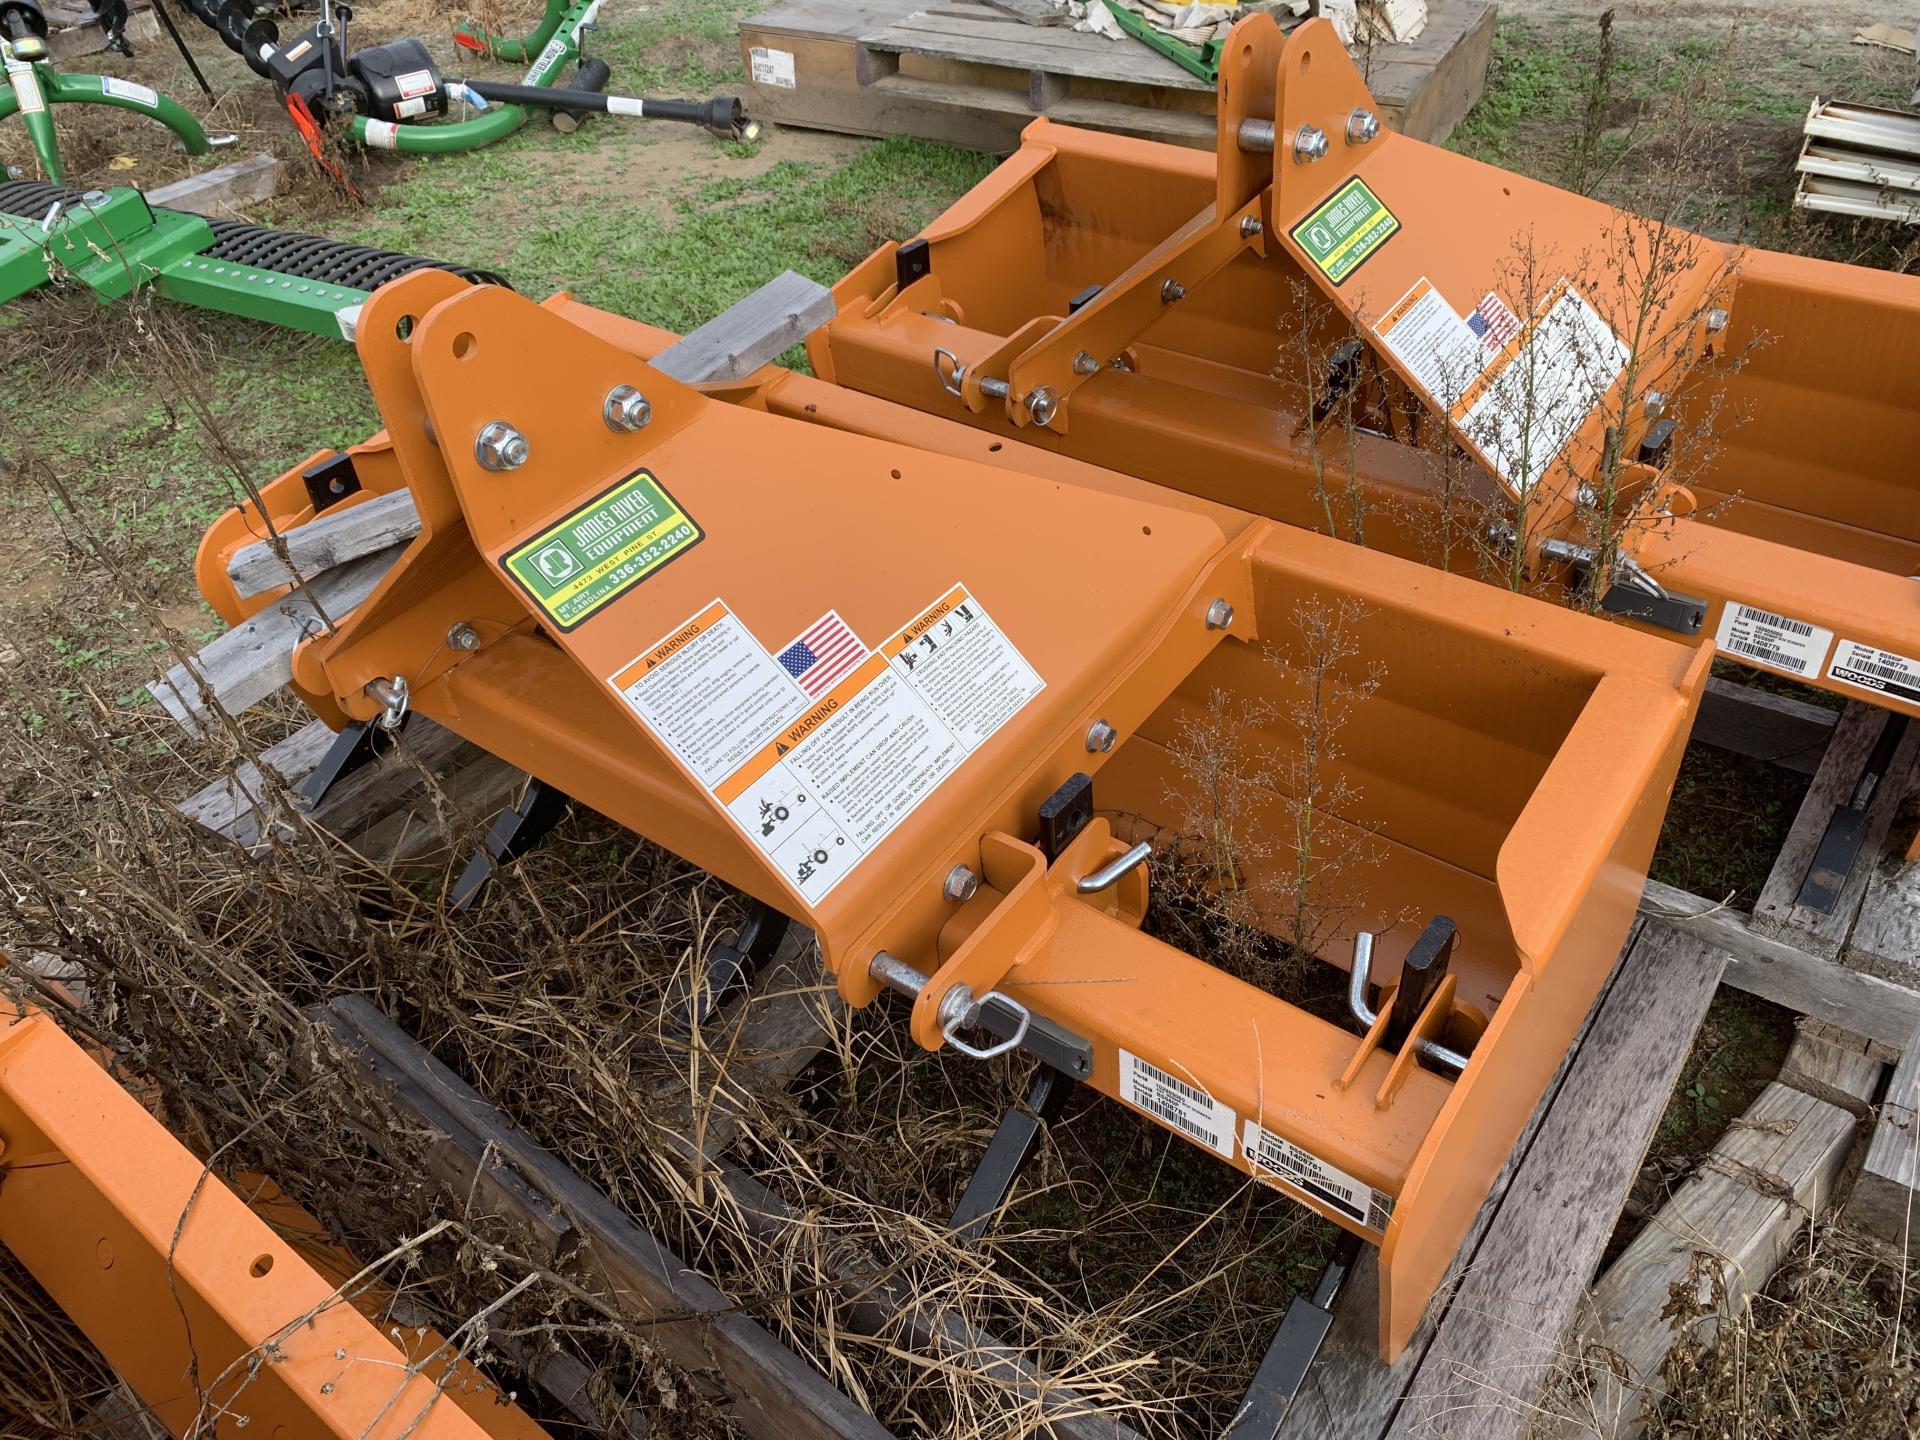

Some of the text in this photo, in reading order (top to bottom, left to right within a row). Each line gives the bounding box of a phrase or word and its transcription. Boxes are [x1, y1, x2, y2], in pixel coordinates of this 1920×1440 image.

[535, 40, 566, 72] FRONTIER
[1324, 189, 1364, 228] JAMES RIVER
[1335, 203, 1371, 237] EQUIPMENT
[1352, 217, 1392, 255] 336-352-2240
[1336, 255, 1355, 273] CAROLINA
[1395, 293, 1418, 316] WARNING
[572, 489, 649, 547] JAMES RIVER
[586, 508, 658, 560] EQUIPMENT
[573, 574, 593, 589] 4473
[595, 555, 619, 574] WEST
[622, 541, 643, 555] PINE
[609, 525, 690, 583] 336-352-2240
[557, 589, 589, 614] MT. AIRY
[571, 585, 611, 613] CAROLINA
[910, 602, 950, 634] WARNING
[1731, 627, 1750, 635] Model#
[1753, 633, 1774, 642] BSS60P
[654, 624, 700, 659] WARNING
[915, 622, 980, 677] CRUSHING AND PINCHING HAZARD
[1730, 632, 1748, 640] Serial#
[1752, 638, 1780, 651] 1408779
[1854, 645, 1902, 662] Model# BSS60P
[634, 682, 644, 690] TO
[642, 670, 660, 684] AVOID
[658, 653, 681, 672] SERIOUS
[680, 640, 699, 656] INJURY
[697, 634, 707, 642] OR
[1851, 650, 1907, 670] Serial# 1408779
[1835, 667, 1885, 689] WOODS
[703, 756, 723, 773] FAILURE
[727, 737, 747, 753] FOLLOW
[746, 726, 760, 738] THESE
[759, 702, 789, 728] INSTRUCTIONS
[787, 695, 797, 704] CAN
[787, 698, 838, 741] WARNING
[788, 744, 811, 765] FALLING
[809, 735, 821, 747] OFF
[819, 726, 831, 738] CAN
[830, 711, 849, 729] RESULT
[853, 694, 869, 709] BEING
[867, 685, 879, 696] RUN
[727, 747, 744, 762] RESULT
[748, 731, 764, 745] INJURY
[820, 781, 840, 800] RAISED
[838, 757, 866, 784] IMPLEMENT
[865, 748, 876, 760] CAN
[875, 736, 889, 750] DROP
[888, 727, 899, 738] AND
[855, 819, 874, 838] FALLING
[874, 810, 884, 820] OFF
[884, 802, 892, 811] OR
[891, 788, 906, 803] GOING
[906, 763, 933, 789] UNDERNEATH
[932, 741, 956, 764] IMPLEMENT
[860, 832, 872, 844] CAN
[871, 816, 888, 833] RESULT
[894, 792, 913, 811] SERIOUS
[912, 778, 928, 794] INJURY
[927, 771, 935, 779] OR
[1133, 1071, 1147, 1082] Part#
[1133, 1078, 1152, 1092] Model#
[1156, 1091, 1178, 1107] BSS60P
[1133, 1084, 1151, 1098] Serial#
[1157, 1097, 1186, 1117] 1408781
[1260, 1135, 1321, 1172] Serial# 1408781
[1261, 1129, 1314, 1162] Model# BSS60P
